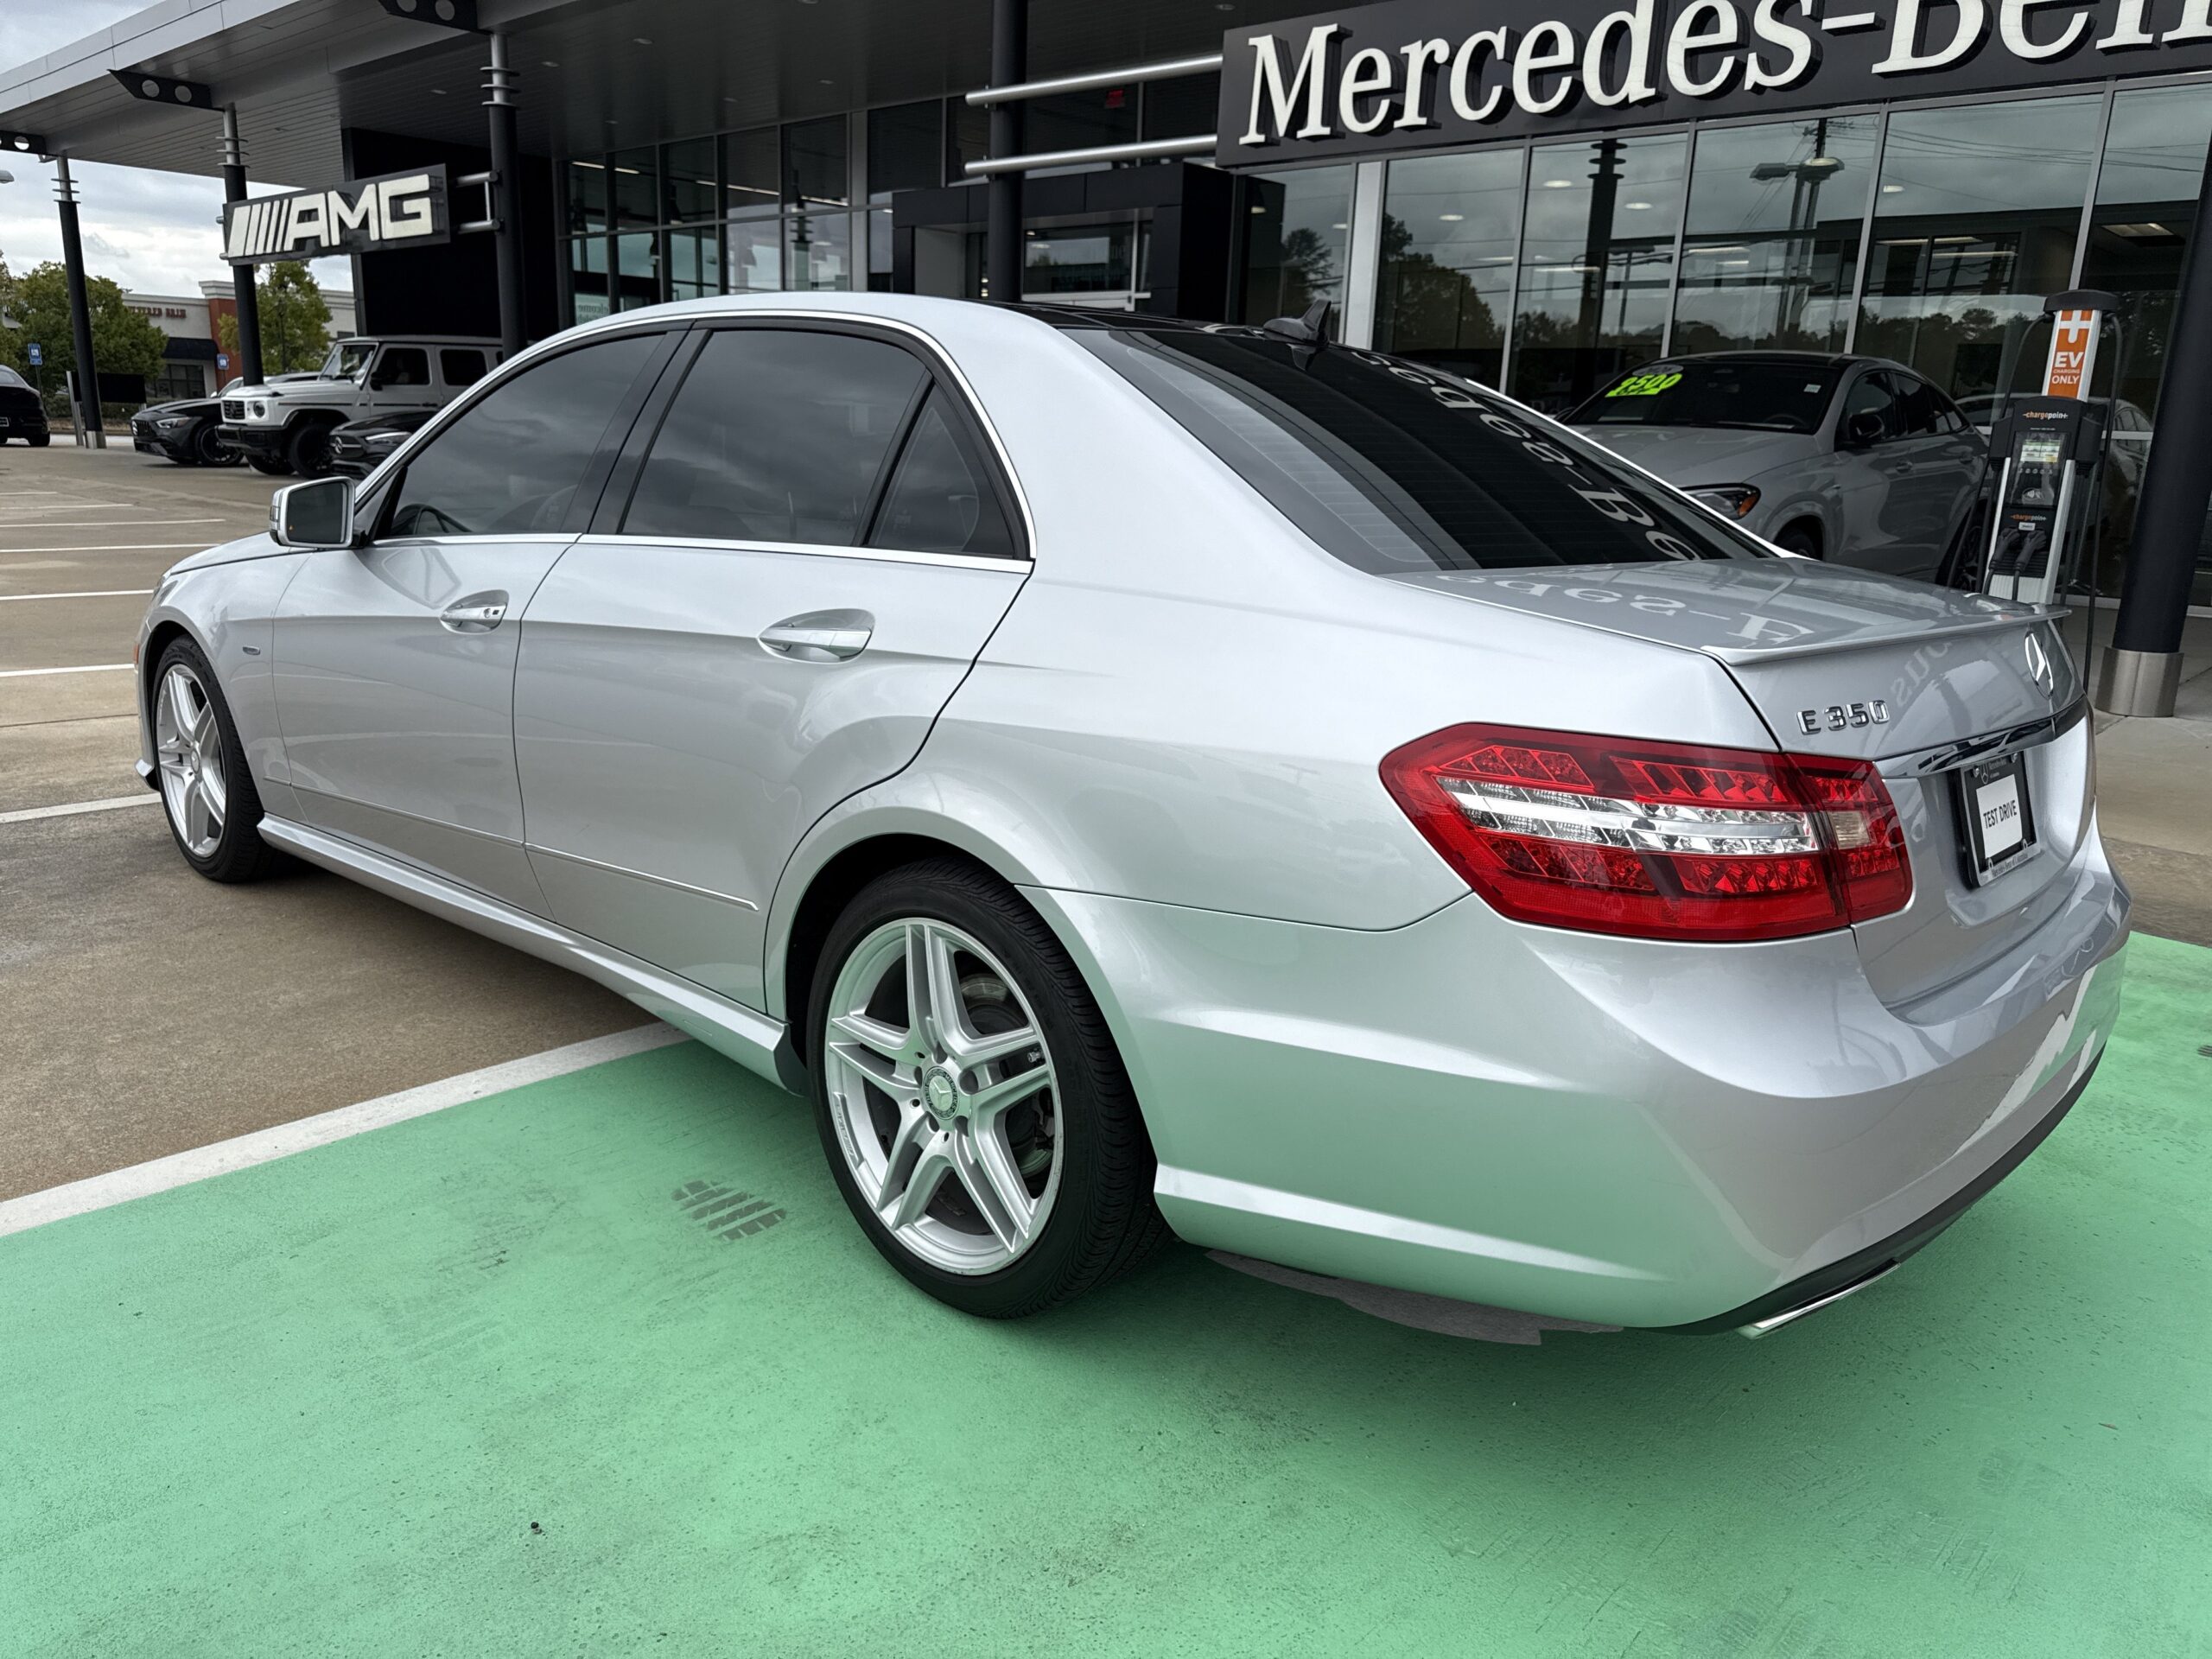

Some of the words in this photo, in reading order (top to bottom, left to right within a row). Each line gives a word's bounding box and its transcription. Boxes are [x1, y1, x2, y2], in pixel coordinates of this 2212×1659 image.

[2054, 352, 2084, 368] EV
[2051, 374, 2080, 385] ONLY
[1796, 709, 1821, 735] E
[1823, 700, 1891, 731] 350
[1983, 808, 1999, 830] TEST
[1999, 799, 2018, 823] DRIVE
